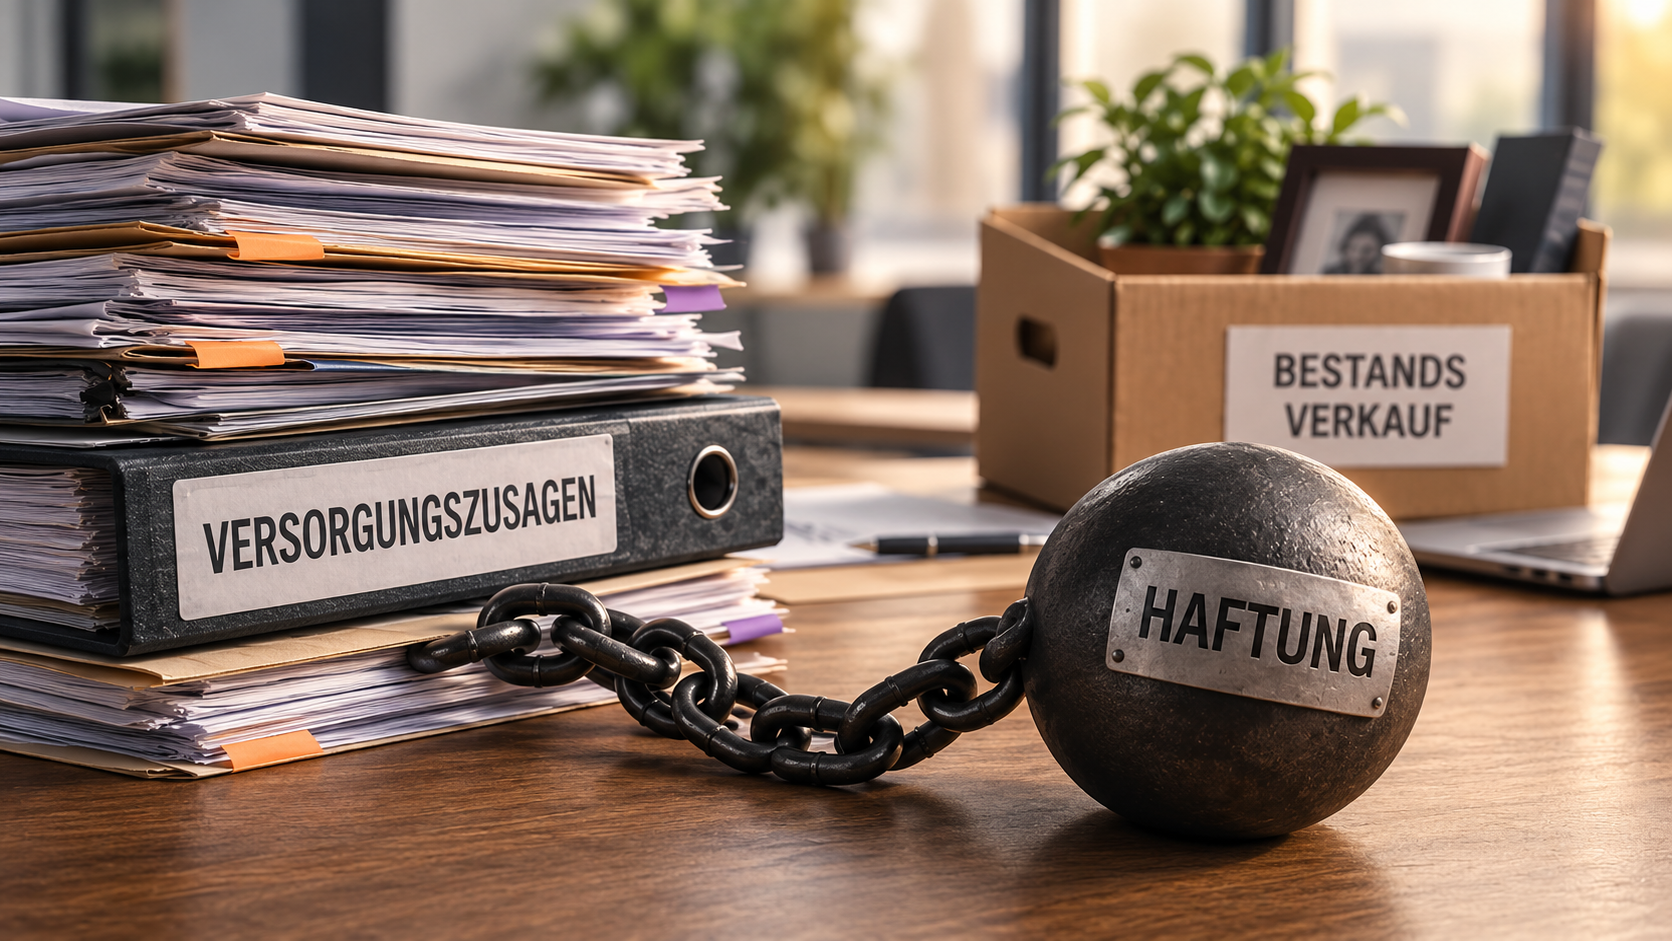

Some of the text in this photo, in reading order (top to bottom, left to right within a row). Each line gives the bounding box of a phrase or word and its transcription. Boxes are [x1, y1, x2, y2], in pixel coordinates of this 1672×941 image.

[1273, 353, 1467, 390] BESTANDS
[1285, 403, 1454, 439] VERKAUF
[202, 474, 597, 574] VERSORGUNGSZUSAGEN
[1138, 585, 1377, 678] HAFTUNG
